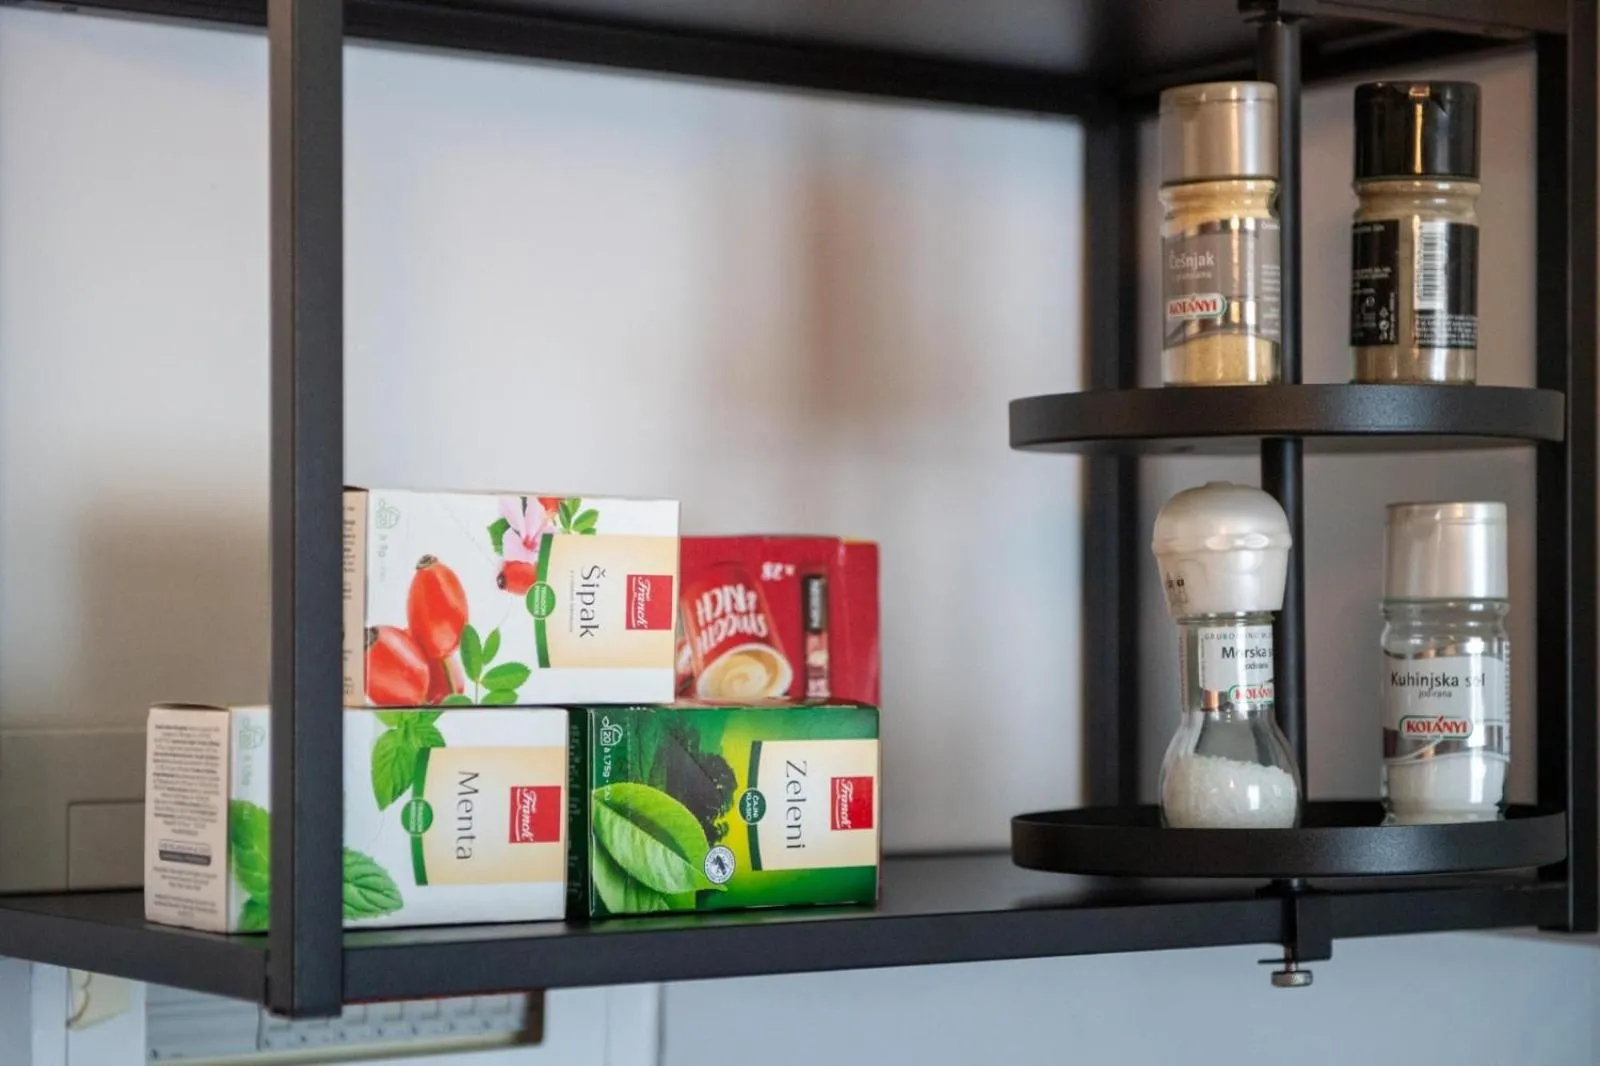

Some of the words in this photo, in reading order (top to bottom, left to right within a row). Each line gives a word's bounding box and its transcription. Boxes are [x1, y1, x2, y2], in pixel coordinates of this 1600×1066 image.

[576, 564, 606, 638] Šipak
[637, 576, 651, 629] Franck
[1221, 646, 1267, 659] Mrska
[1391, 672, 1459, 689] Kuhinjska
[1464, 673, 1486, 687] sl
[1406, 716, 1468, 734] KOTÁNYI
[455, 770, 480, 860] Menta
[521, 787, 538, 842] Franck
[785, 760, 808, 850] Zeleni
[840, 777, 854, 829] Franck
